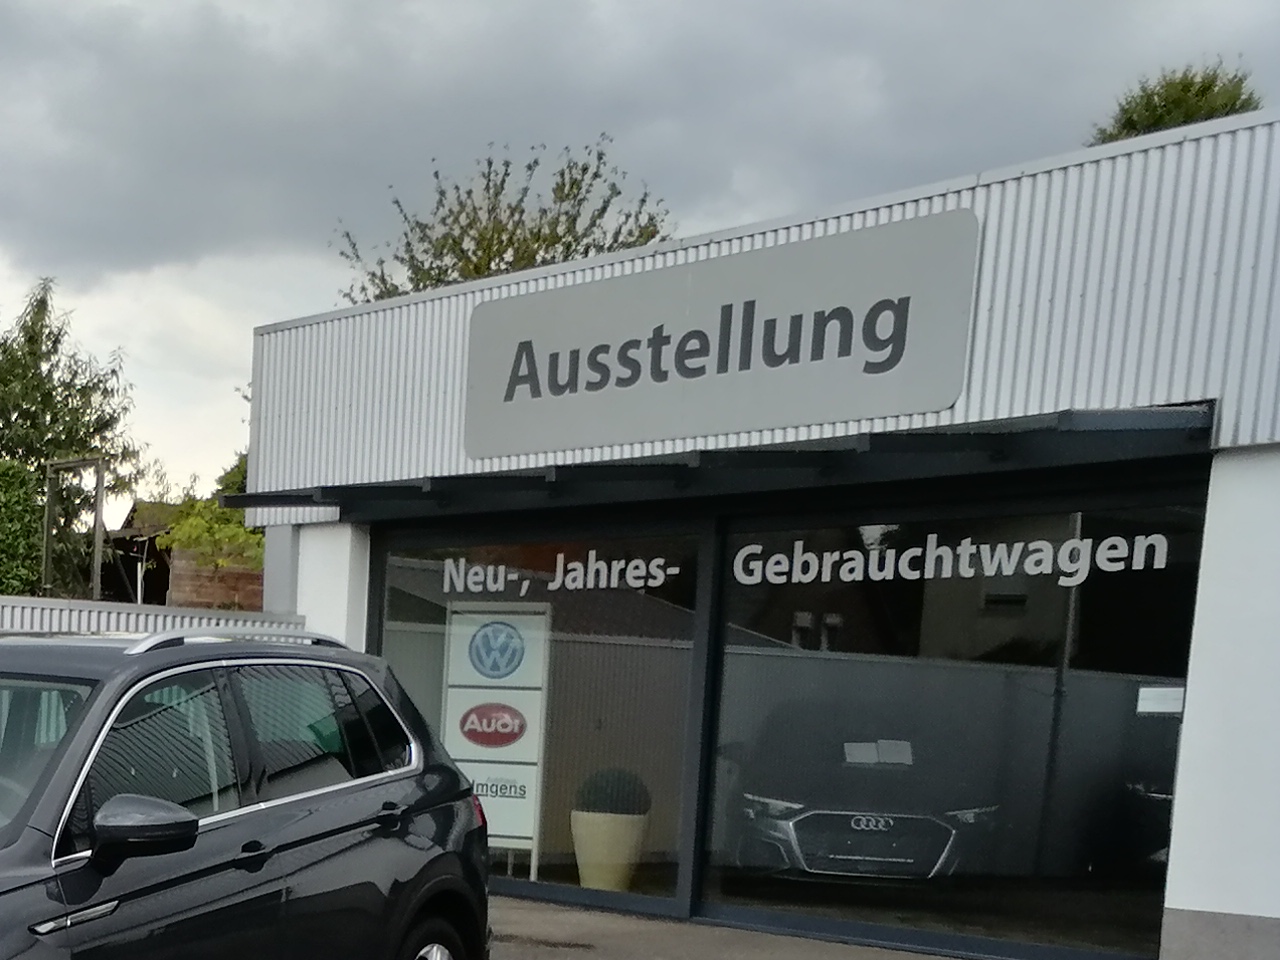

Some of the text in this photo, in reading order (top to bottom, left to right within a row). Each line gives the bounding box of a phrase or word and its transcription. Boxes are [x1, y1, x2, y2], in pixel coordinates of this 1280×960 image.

[503, 295, 912, 402] Ausstellung
[443, 533, 1169, 597] Neu-, Jahres- Gebrauchtwagen
[463, 713, 521, 733] Audi
